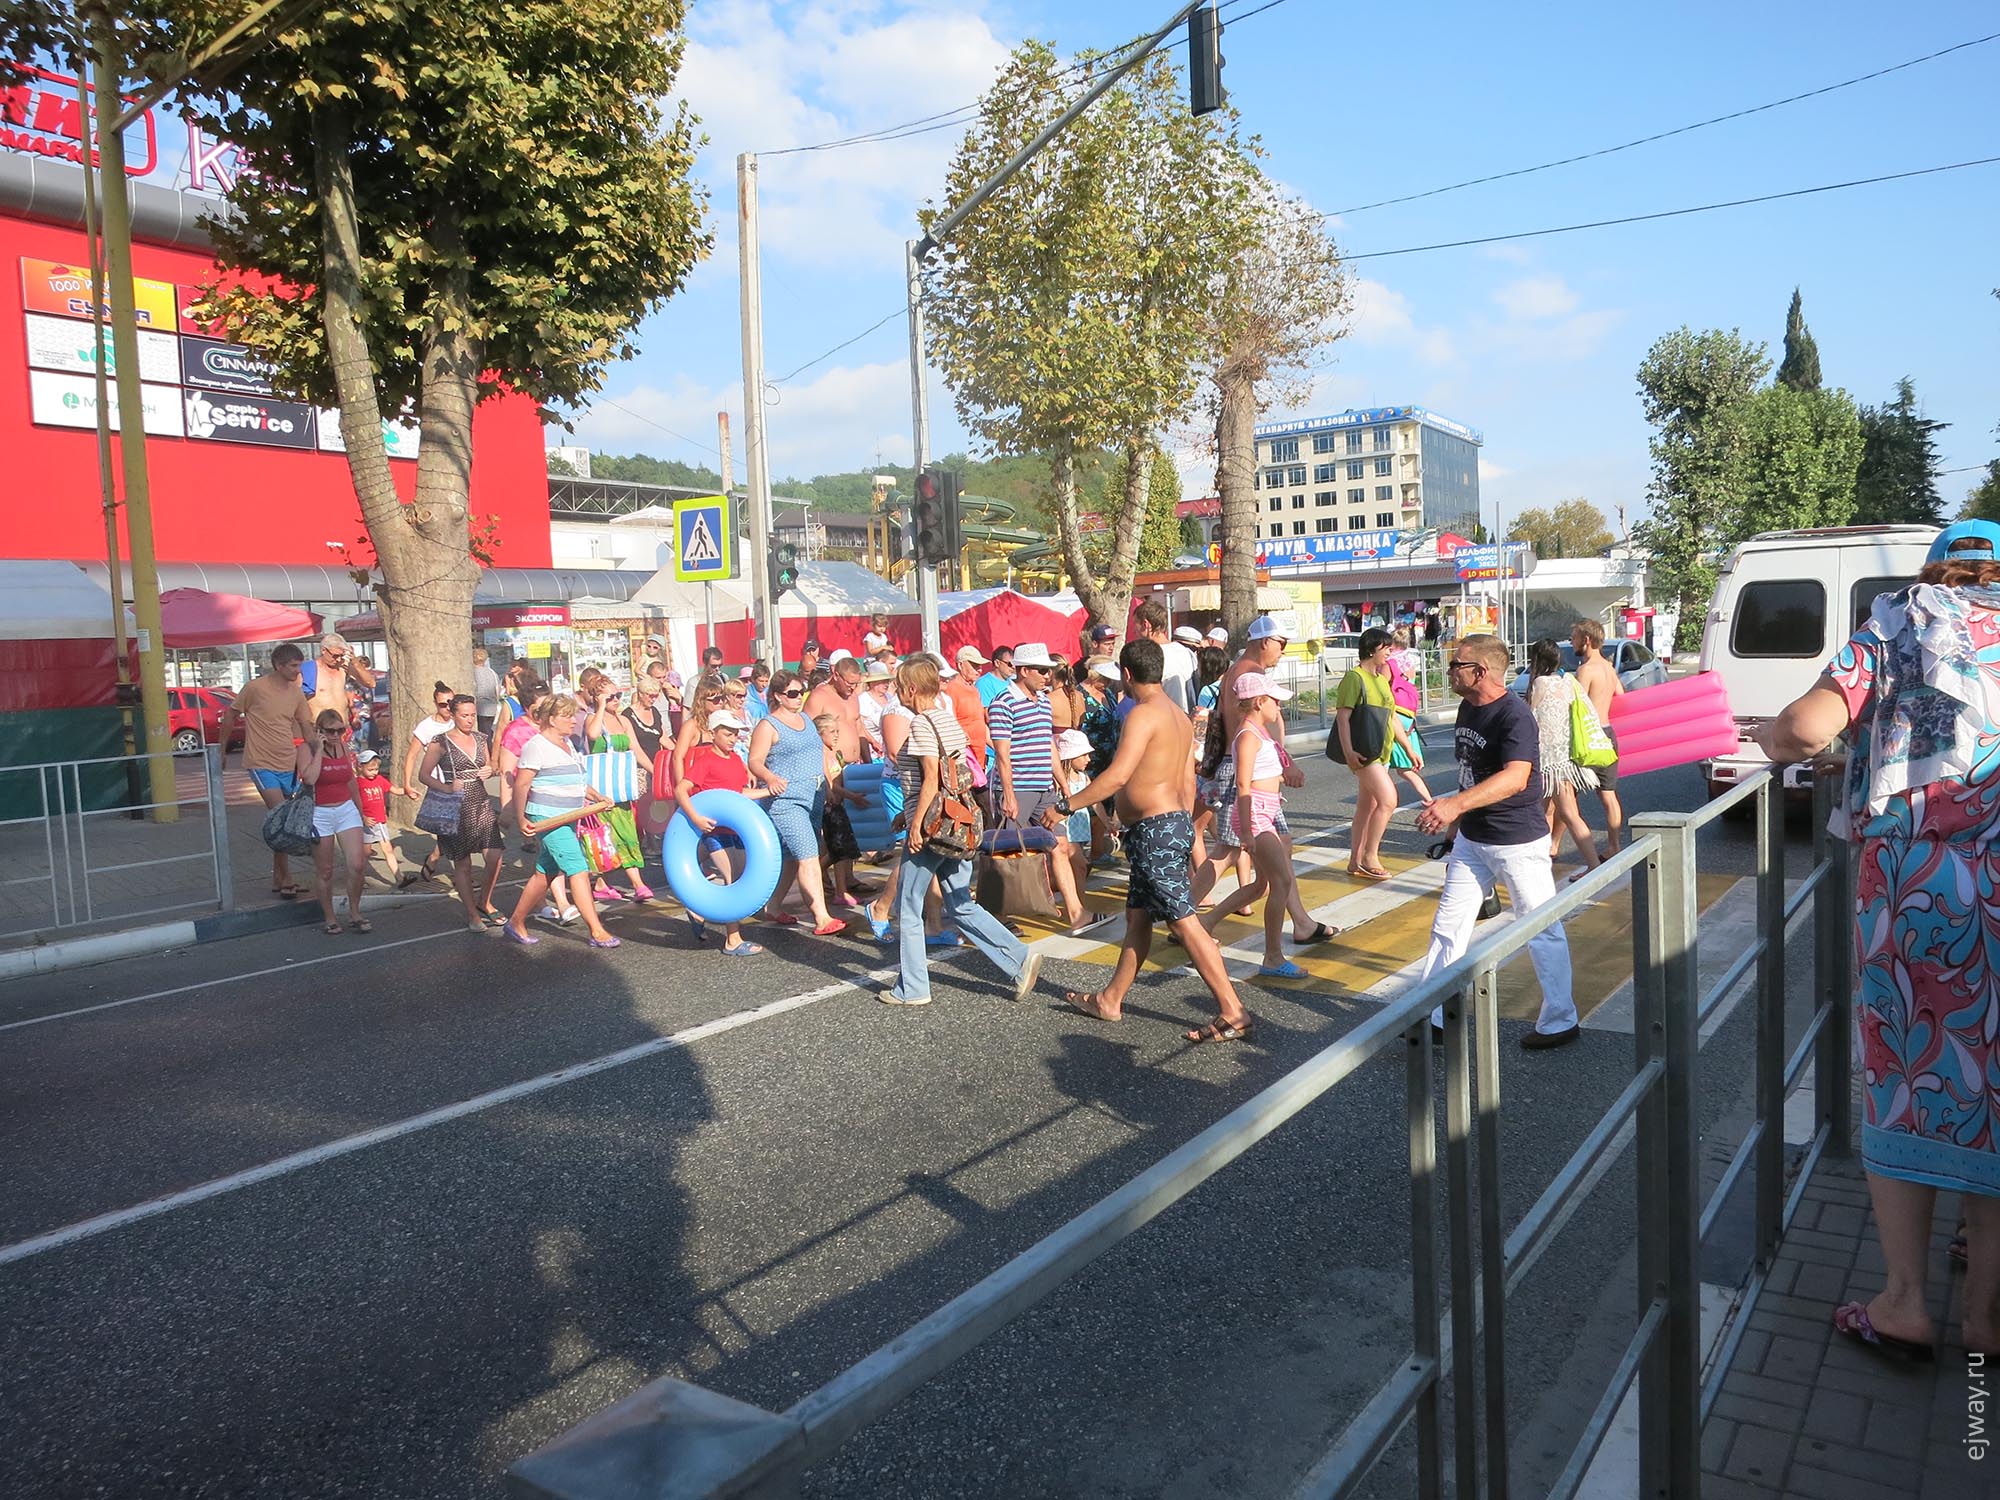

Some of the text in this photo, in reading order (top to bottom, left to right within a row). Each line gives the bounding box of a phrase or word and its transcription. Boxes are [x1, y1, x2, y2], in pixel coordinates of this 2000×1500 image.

[48, 280, 80, 292] 1000
[225, 404, 259, 415] apple
[1468, 570, 1477, 578] 10
[515, 613, 563, 623] ЭКСКУРСИИ
